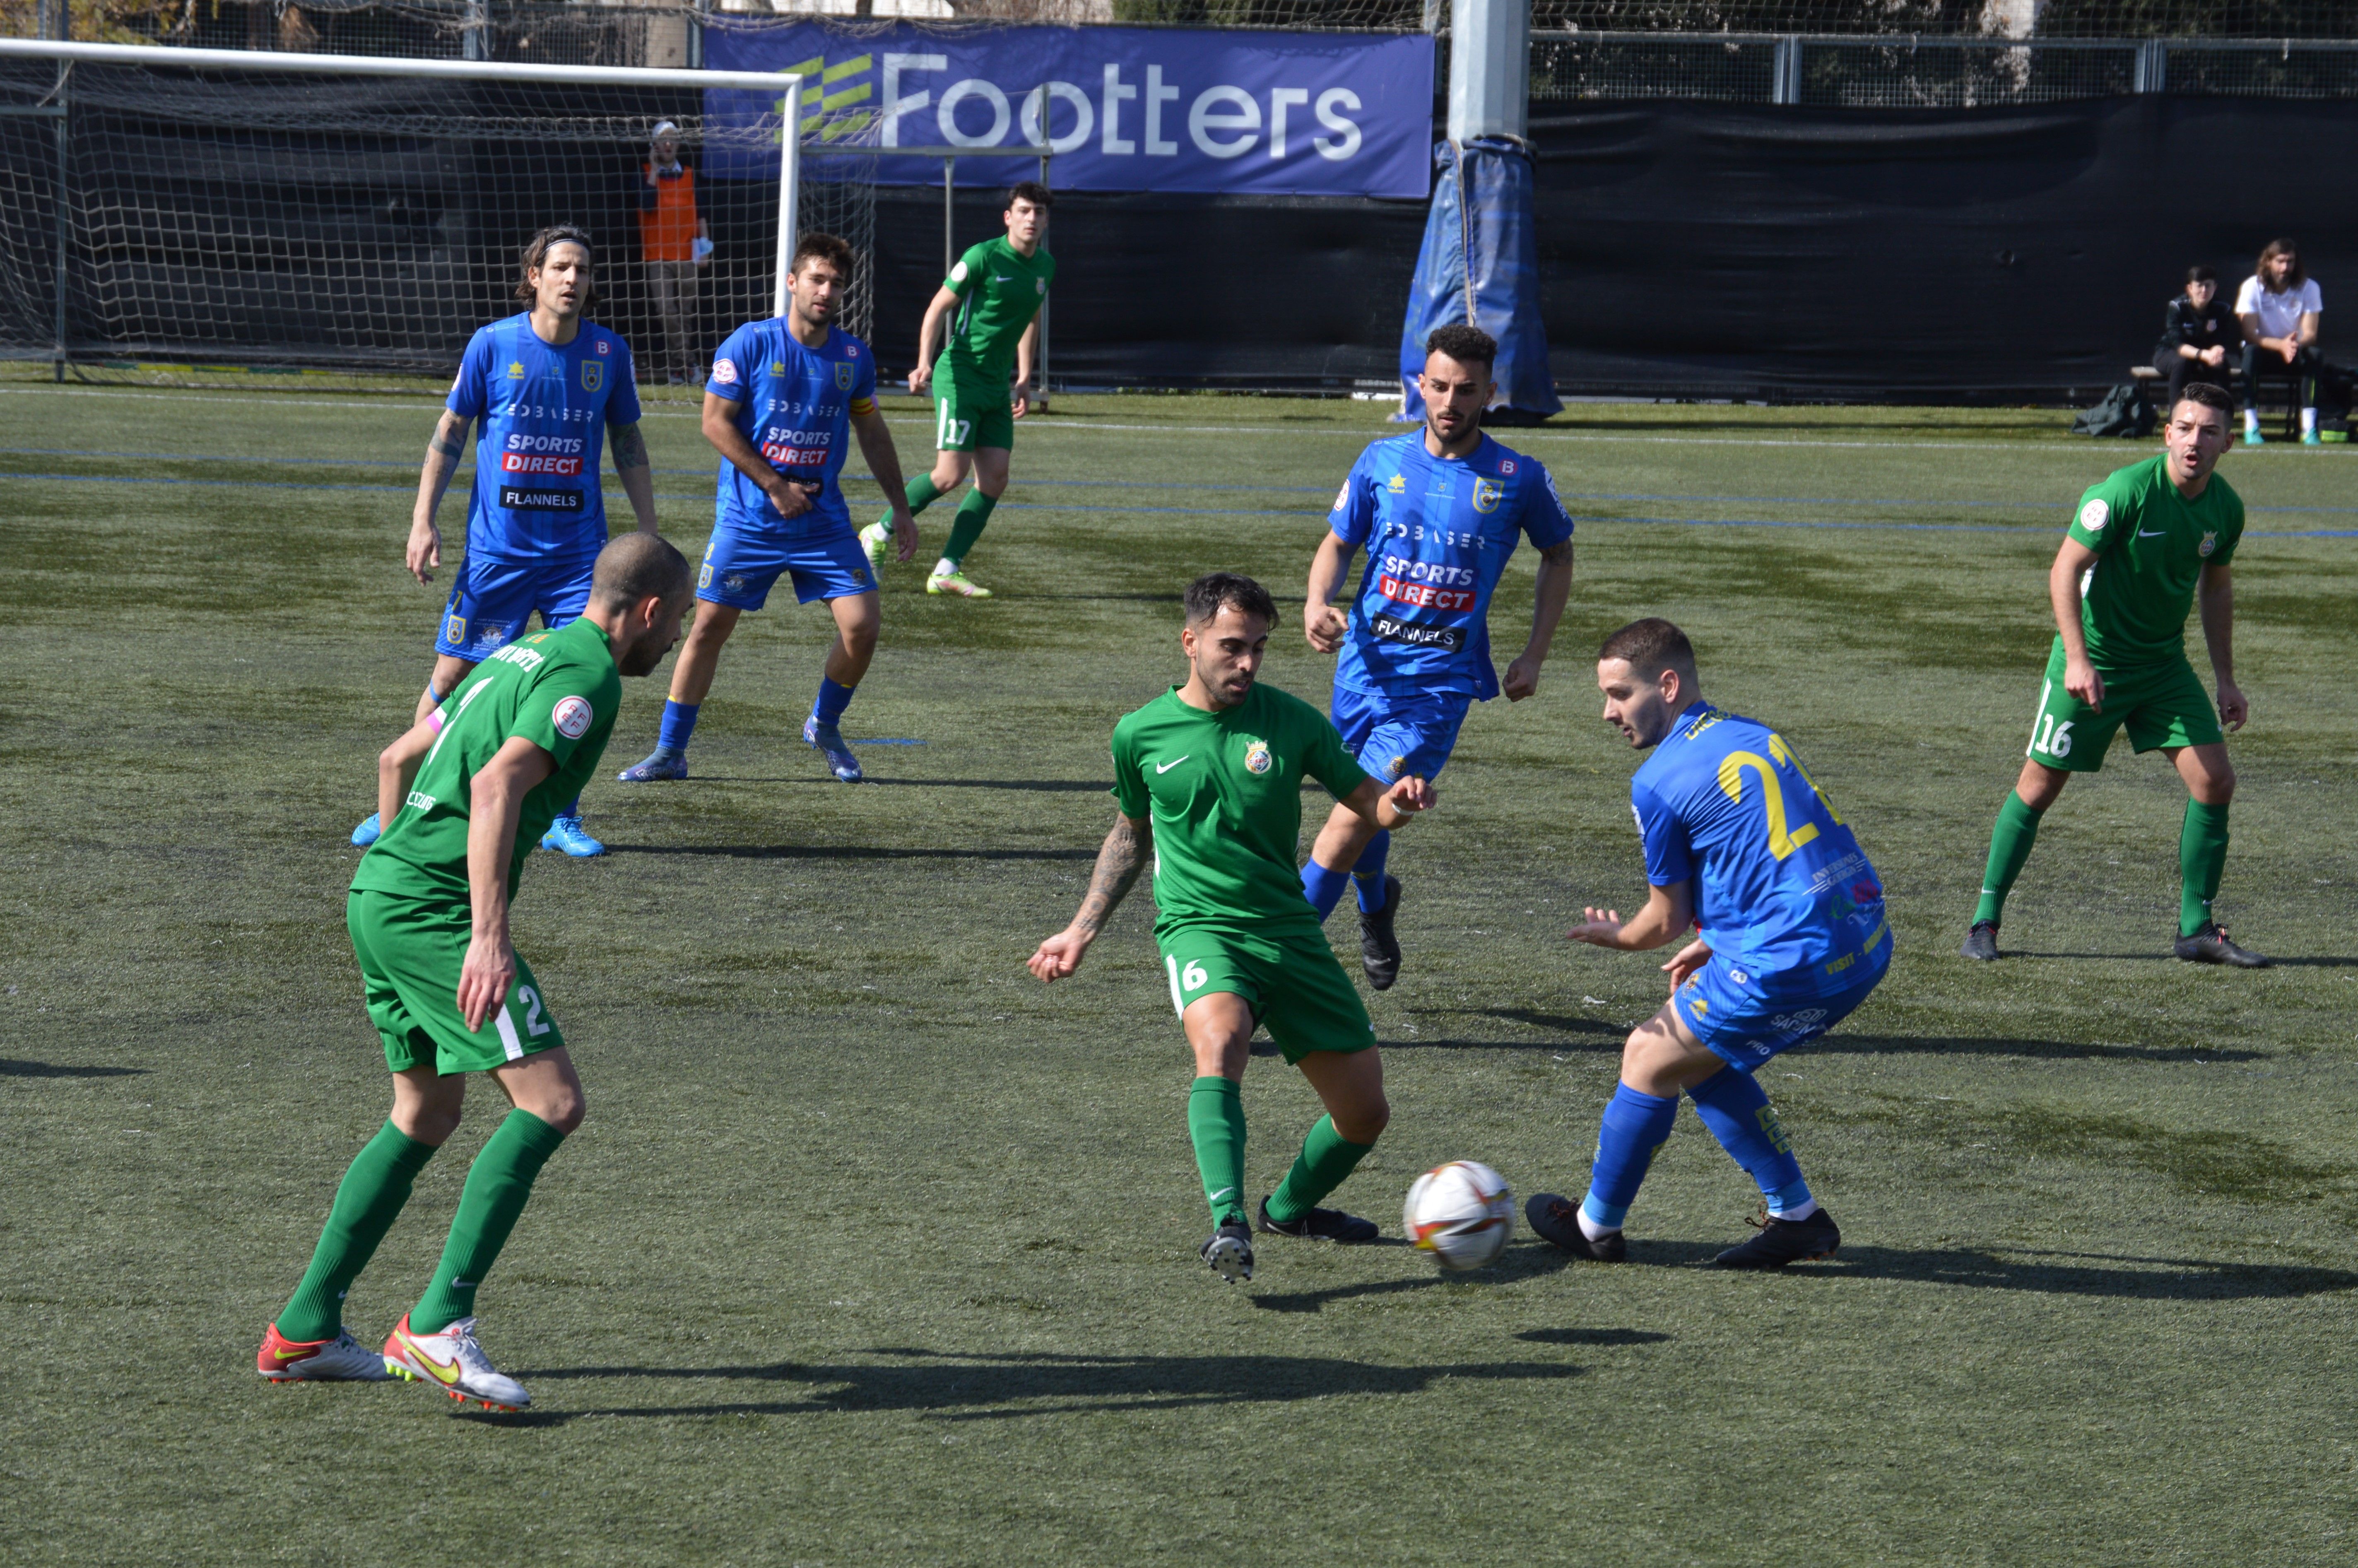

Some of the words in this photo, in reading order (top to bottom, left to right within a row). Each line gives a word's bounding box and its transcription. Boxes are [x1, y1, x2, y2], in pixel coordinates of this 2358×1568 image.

[882, 53, 1362, 160] Footters
[507, 434, 583, 453] SPORTS
[768, 426, 831, 445] SPORTS
[945, 419, 971, 445] 17
[506, 455, 579, 474] DIRECT
[766, 445, 826, 464] DIRECT
[506, 491, 577, 507] FLANNELS
[706, 542, 715, 560] 8
[1385, 556, 1474, 586] SPORTS
[1384, 579, 1469, 608] DIRECT
[1378, 619, 1455, 645] FLANNELS
[2035, 713, 2075, 757] 16
[1718, 733, 1844, 862] 21
[1182, 959, 1208, 992] 6
[518, 985, 550, 1037] 2
